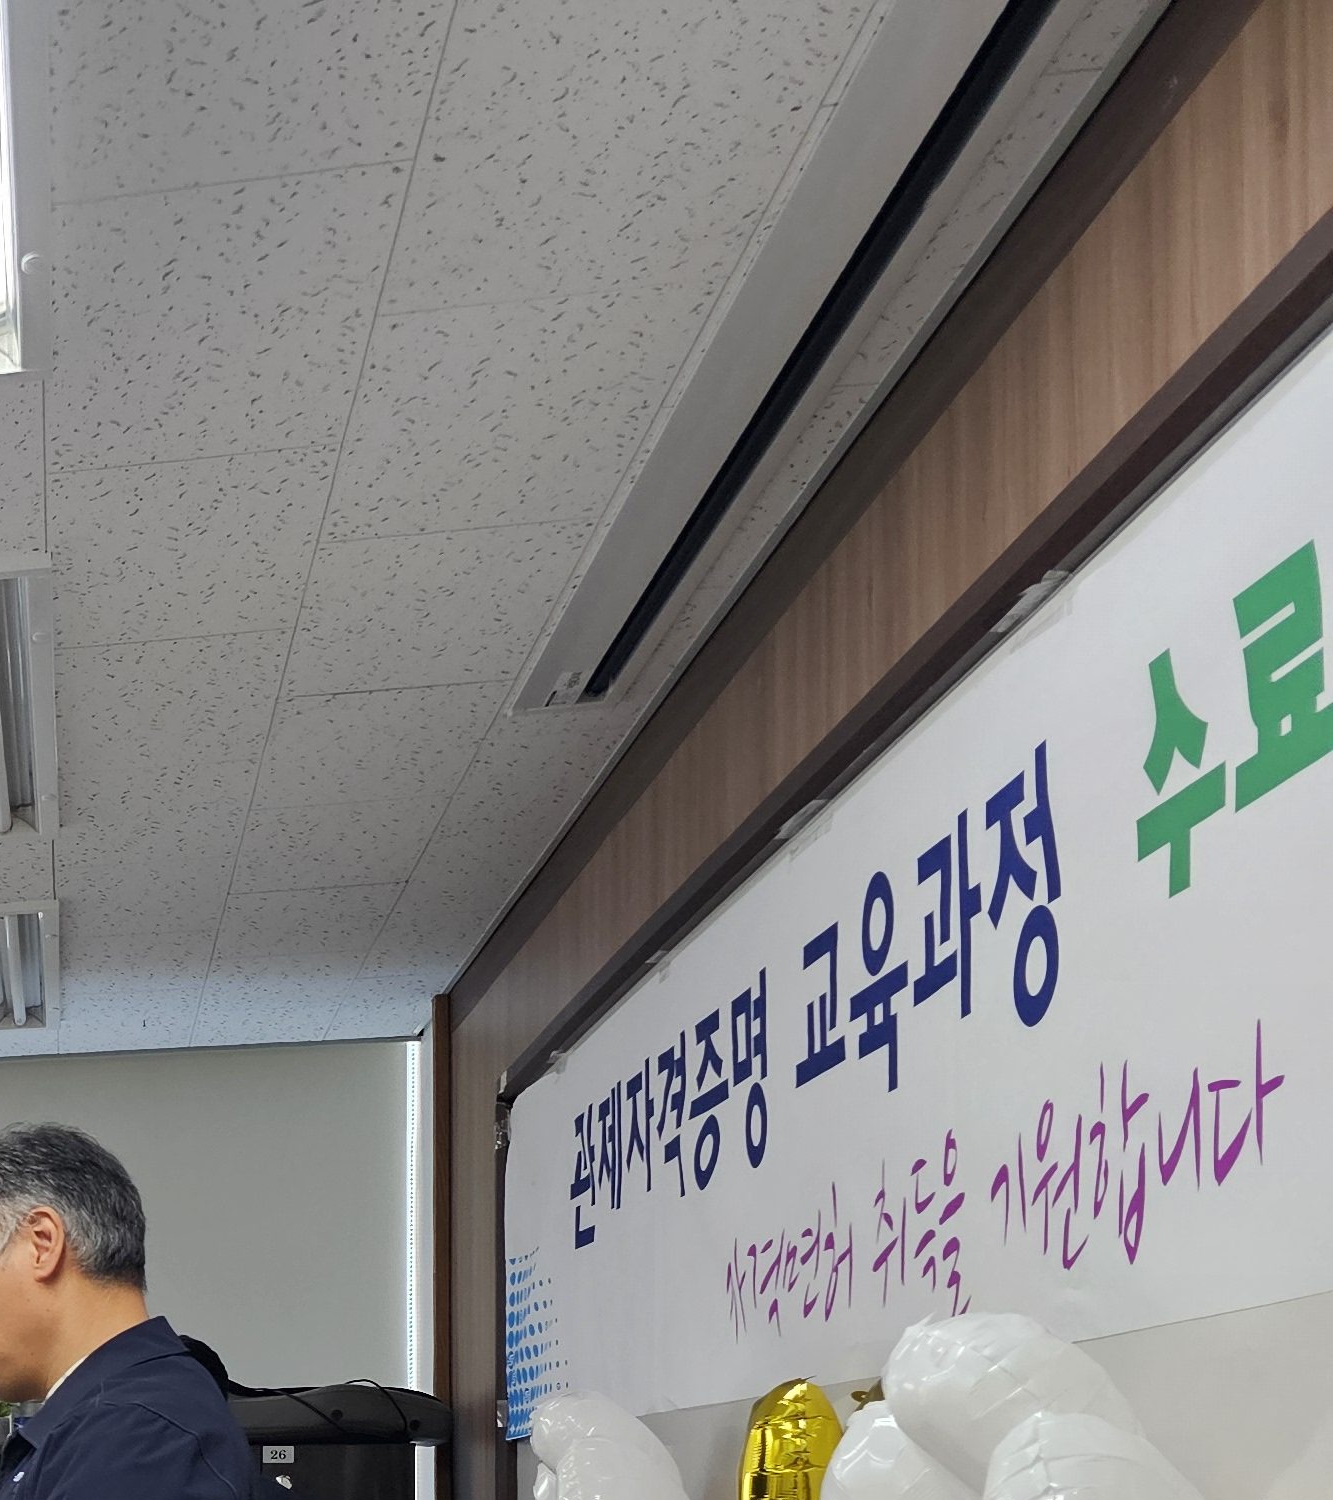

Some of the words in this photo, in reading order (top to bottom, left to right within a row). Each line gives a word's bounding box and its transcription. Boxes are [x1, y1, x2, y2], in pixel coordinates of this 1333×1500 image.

[570, 966, 768, 1250] 관제자격증명
[795, 739, 1061, 1093] 교육과정
[1136, 538, 1333, 899] 수료
[726, 1181, 853, 1344] 자격면허
[872, 1128, 972, 1318] 취득을
[990, 1018, 1285, 1271] 기원합니다
[270, 1450, 287, 1460] 26
